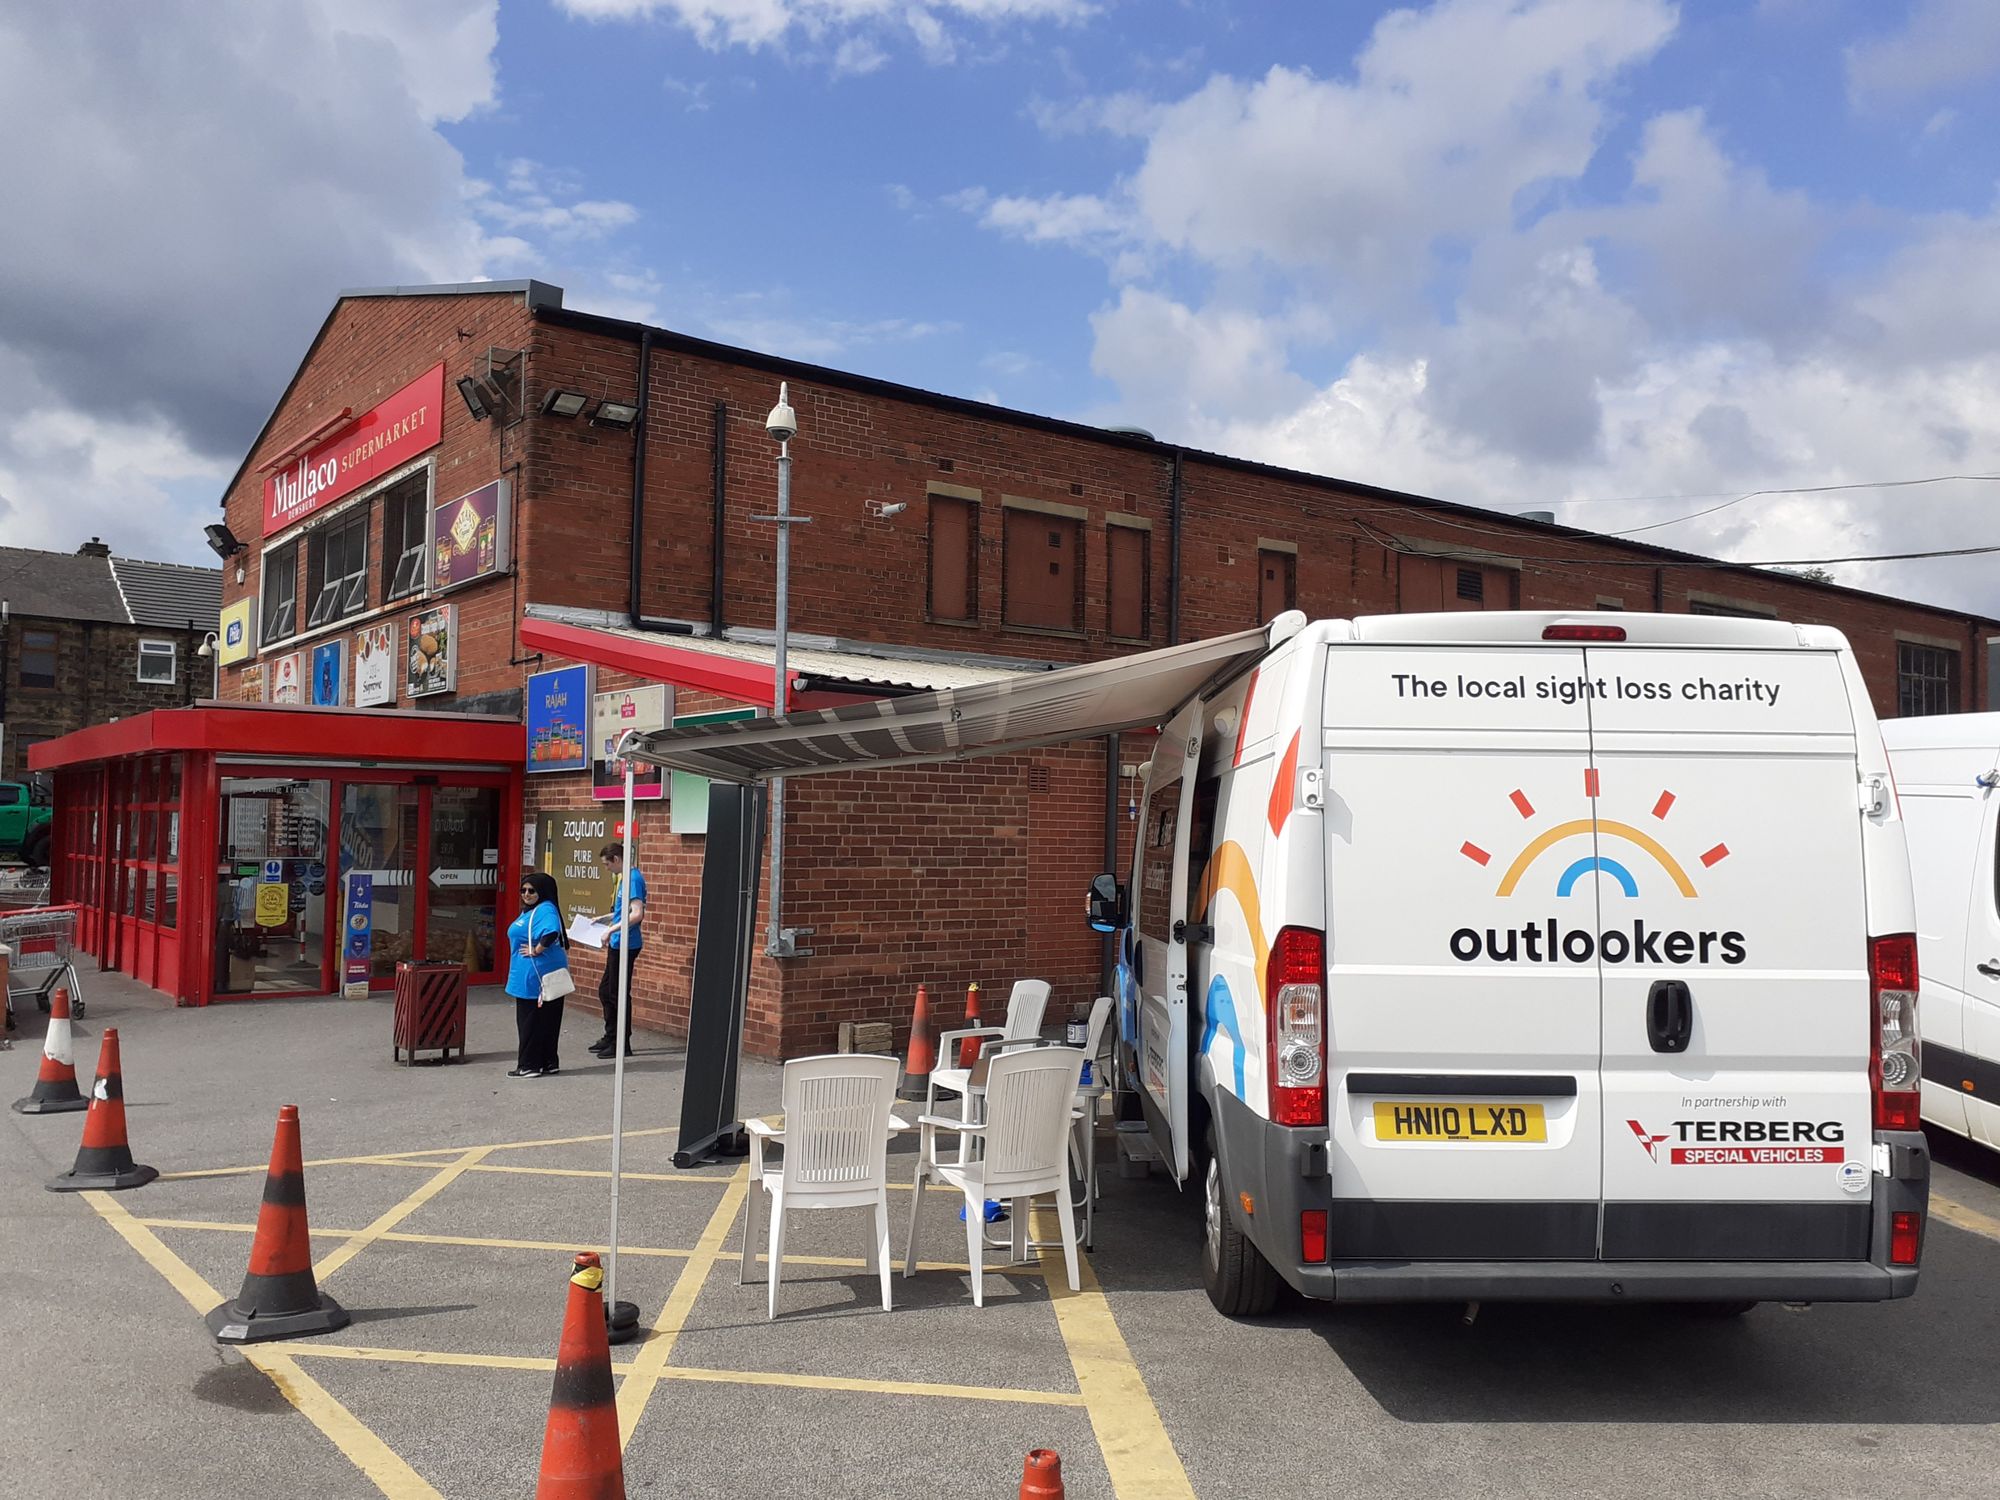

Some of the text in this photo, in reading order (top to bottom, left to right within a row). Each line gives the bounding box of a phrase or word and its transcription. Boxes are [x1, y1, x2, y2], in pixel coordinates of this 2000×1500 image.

[341, 406, 427, 473] SUPERMARKET
[271, 453, 338, 518] Mullaco
[545, 692, 568, 710] RAJAH
[1391, 674, 1781, 707] The local sight loss charity
[563, 817, 604, 842] zaytuna
[573, 849, 592, 863] PURE
[564, 865, 600, 880] OLIVE OIL
[1449, 918, 1747, 965] outlookers
[1681, 1096, 1787, 1110] In partnership with
[1393, 1106, 1527, 1136] HN10 LXD
[1671, 1121, 1845, 1143] TERBERG
[1684, 1149, 1824, 1164] SPECIAL VEHICLES
